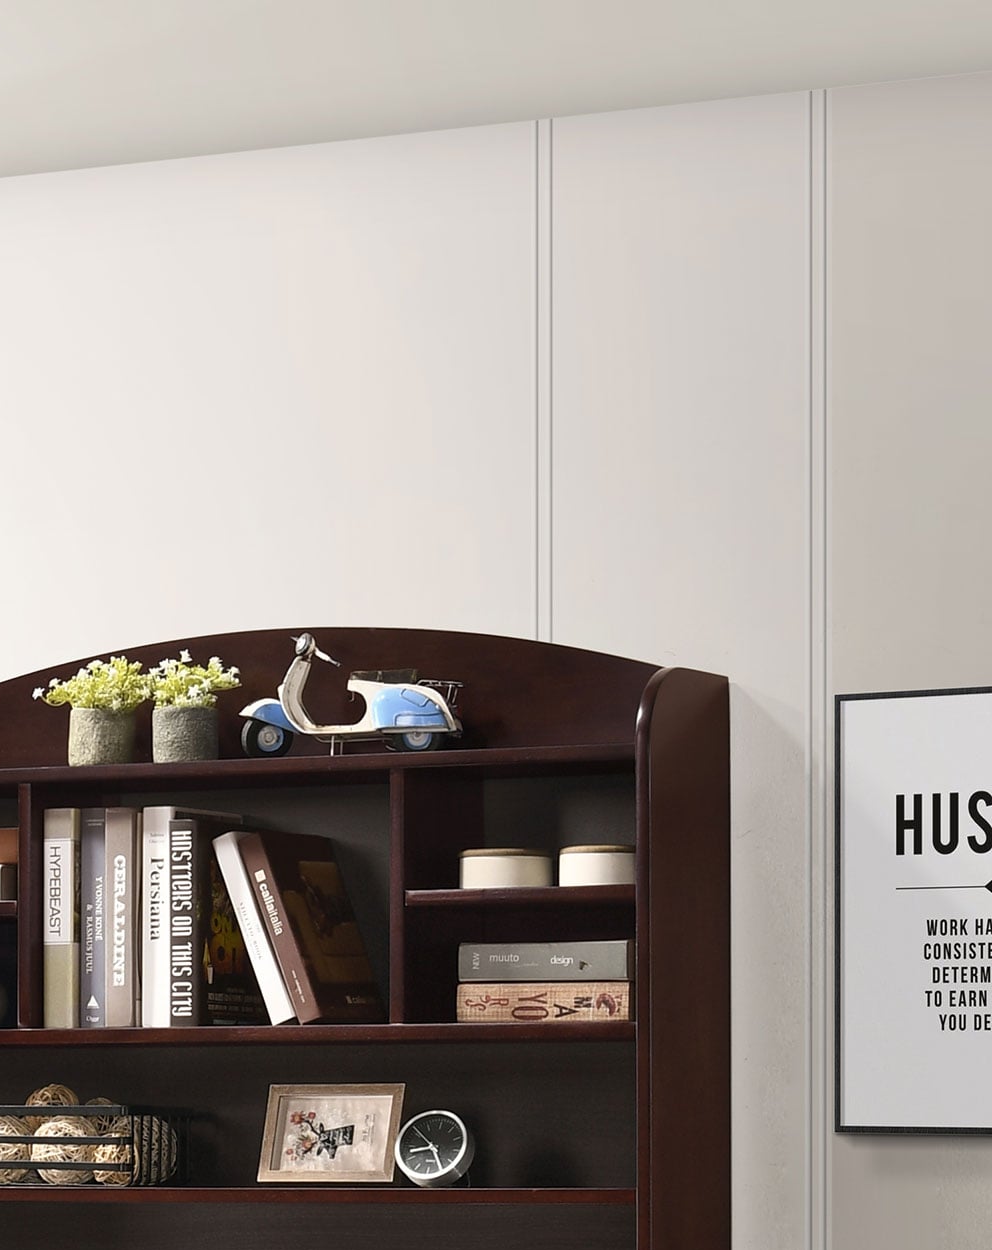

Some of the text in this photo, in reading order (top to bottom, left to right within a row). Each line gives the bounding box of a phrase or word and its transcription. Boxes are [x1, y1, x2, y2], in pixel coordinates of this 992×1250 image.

[895, 790, 992, 855] HUS
[49, 846, 61, 937] HYPEBEAST
[150, 857, 165, 941] Persiana
[259, 883, 283, 936] callaitalia
[171, 916, 192, 937] ON
[926, 918, 992, 936] WORK HA
[171, 942, 192, 977] THIS
[489, 953, 520, 963] muuto
[923, 942, 992, 960] CONSISTE
[472, 952, 480, 970] NEW
[550, 954, 574, 967] design
[932, 966, 992, 983] DETERM
[171, 981, 192, 1017] CITY
[924, 990, 987, 1007] TO EARN
[938, 1013, 992, 1031] YOU DE
